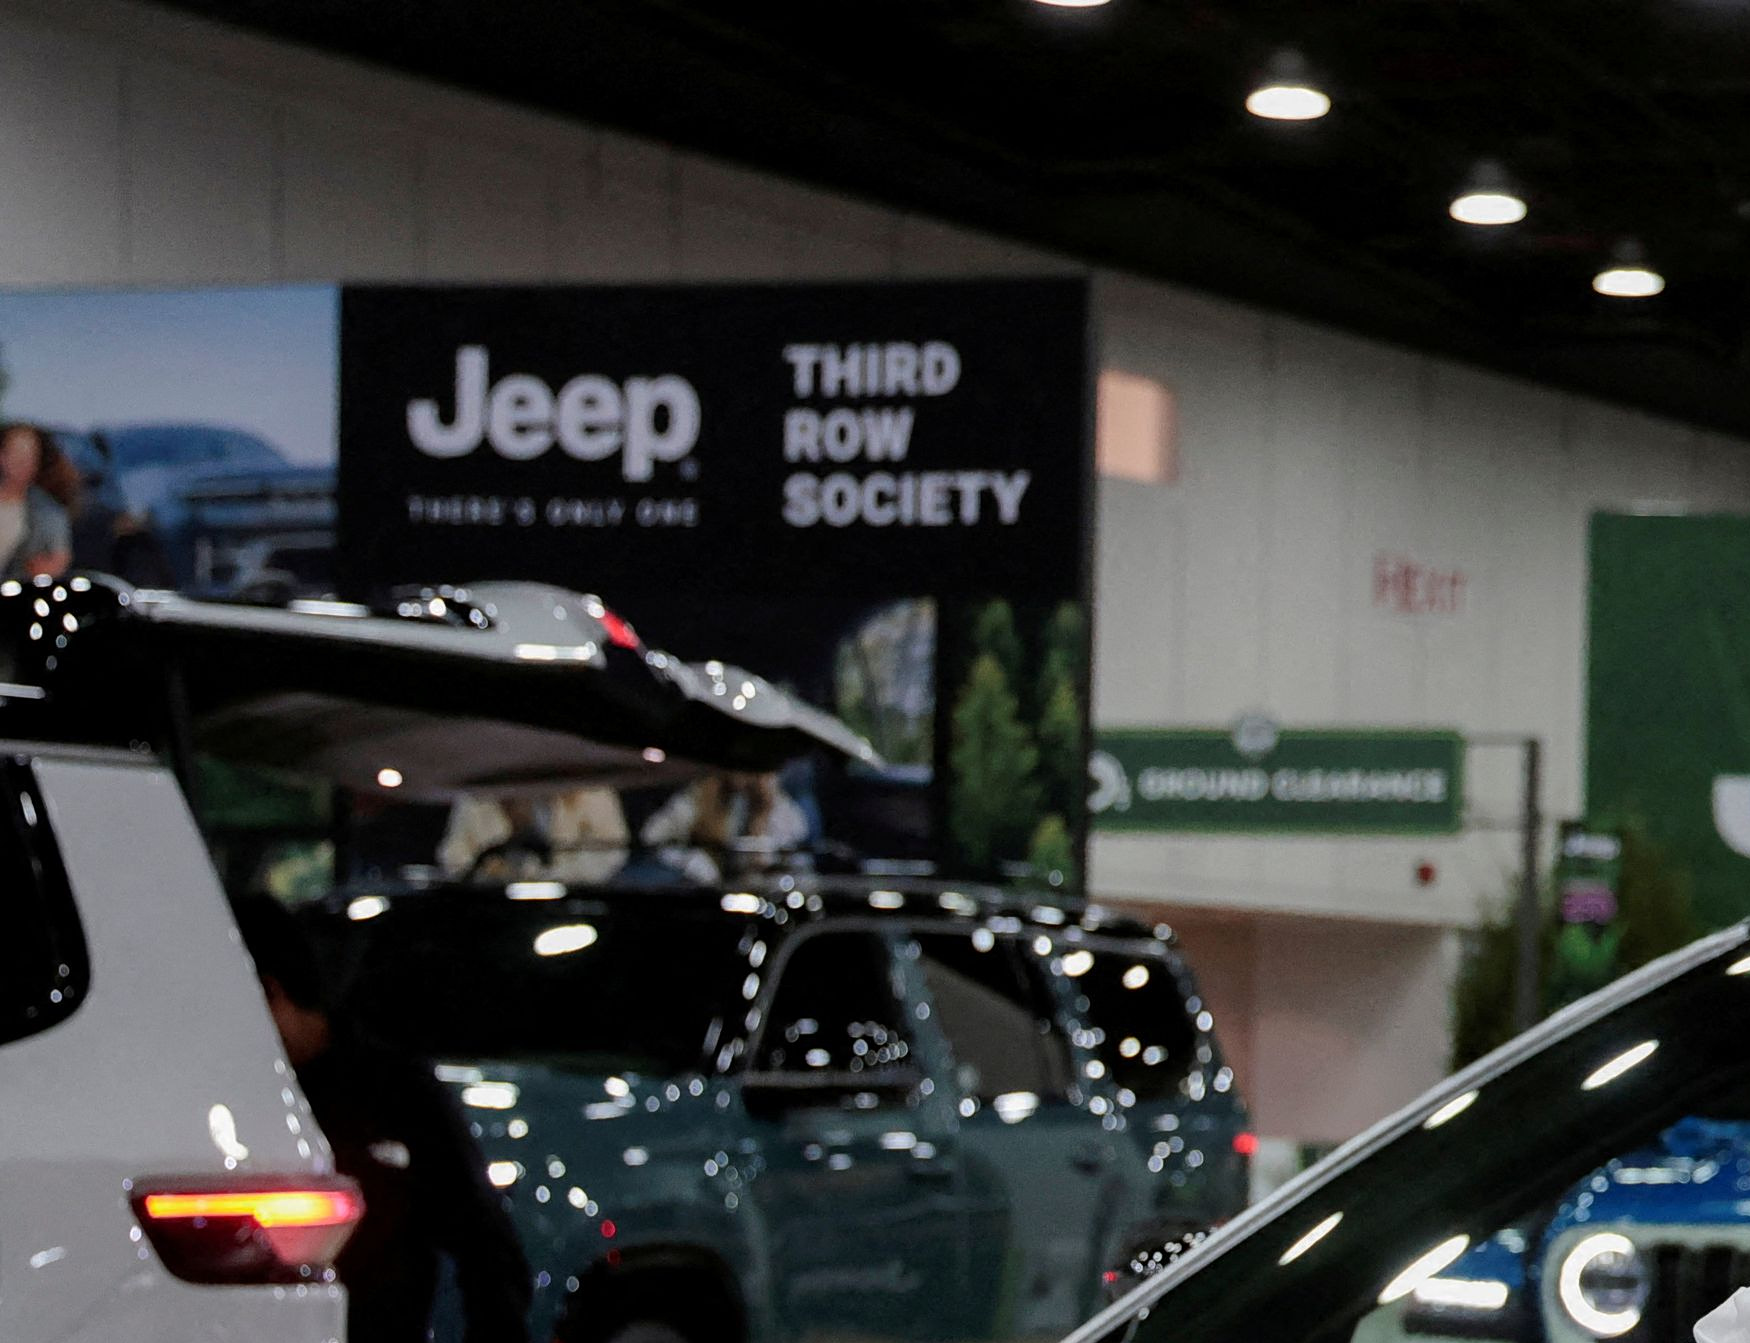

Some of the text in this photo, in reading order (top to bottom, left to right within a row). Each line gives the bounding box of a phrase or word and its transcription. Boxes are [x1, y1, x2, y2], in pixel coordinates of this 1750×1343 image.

[783, 341, 962, 398] THIRD
[406, 344, 700, 482] Jeep
[783, 408, 914, 462] ROW
[783, 470, 1030, 527] SOCIETY
[1138, 766, 1447, 802] GROUND CLEARANCE
